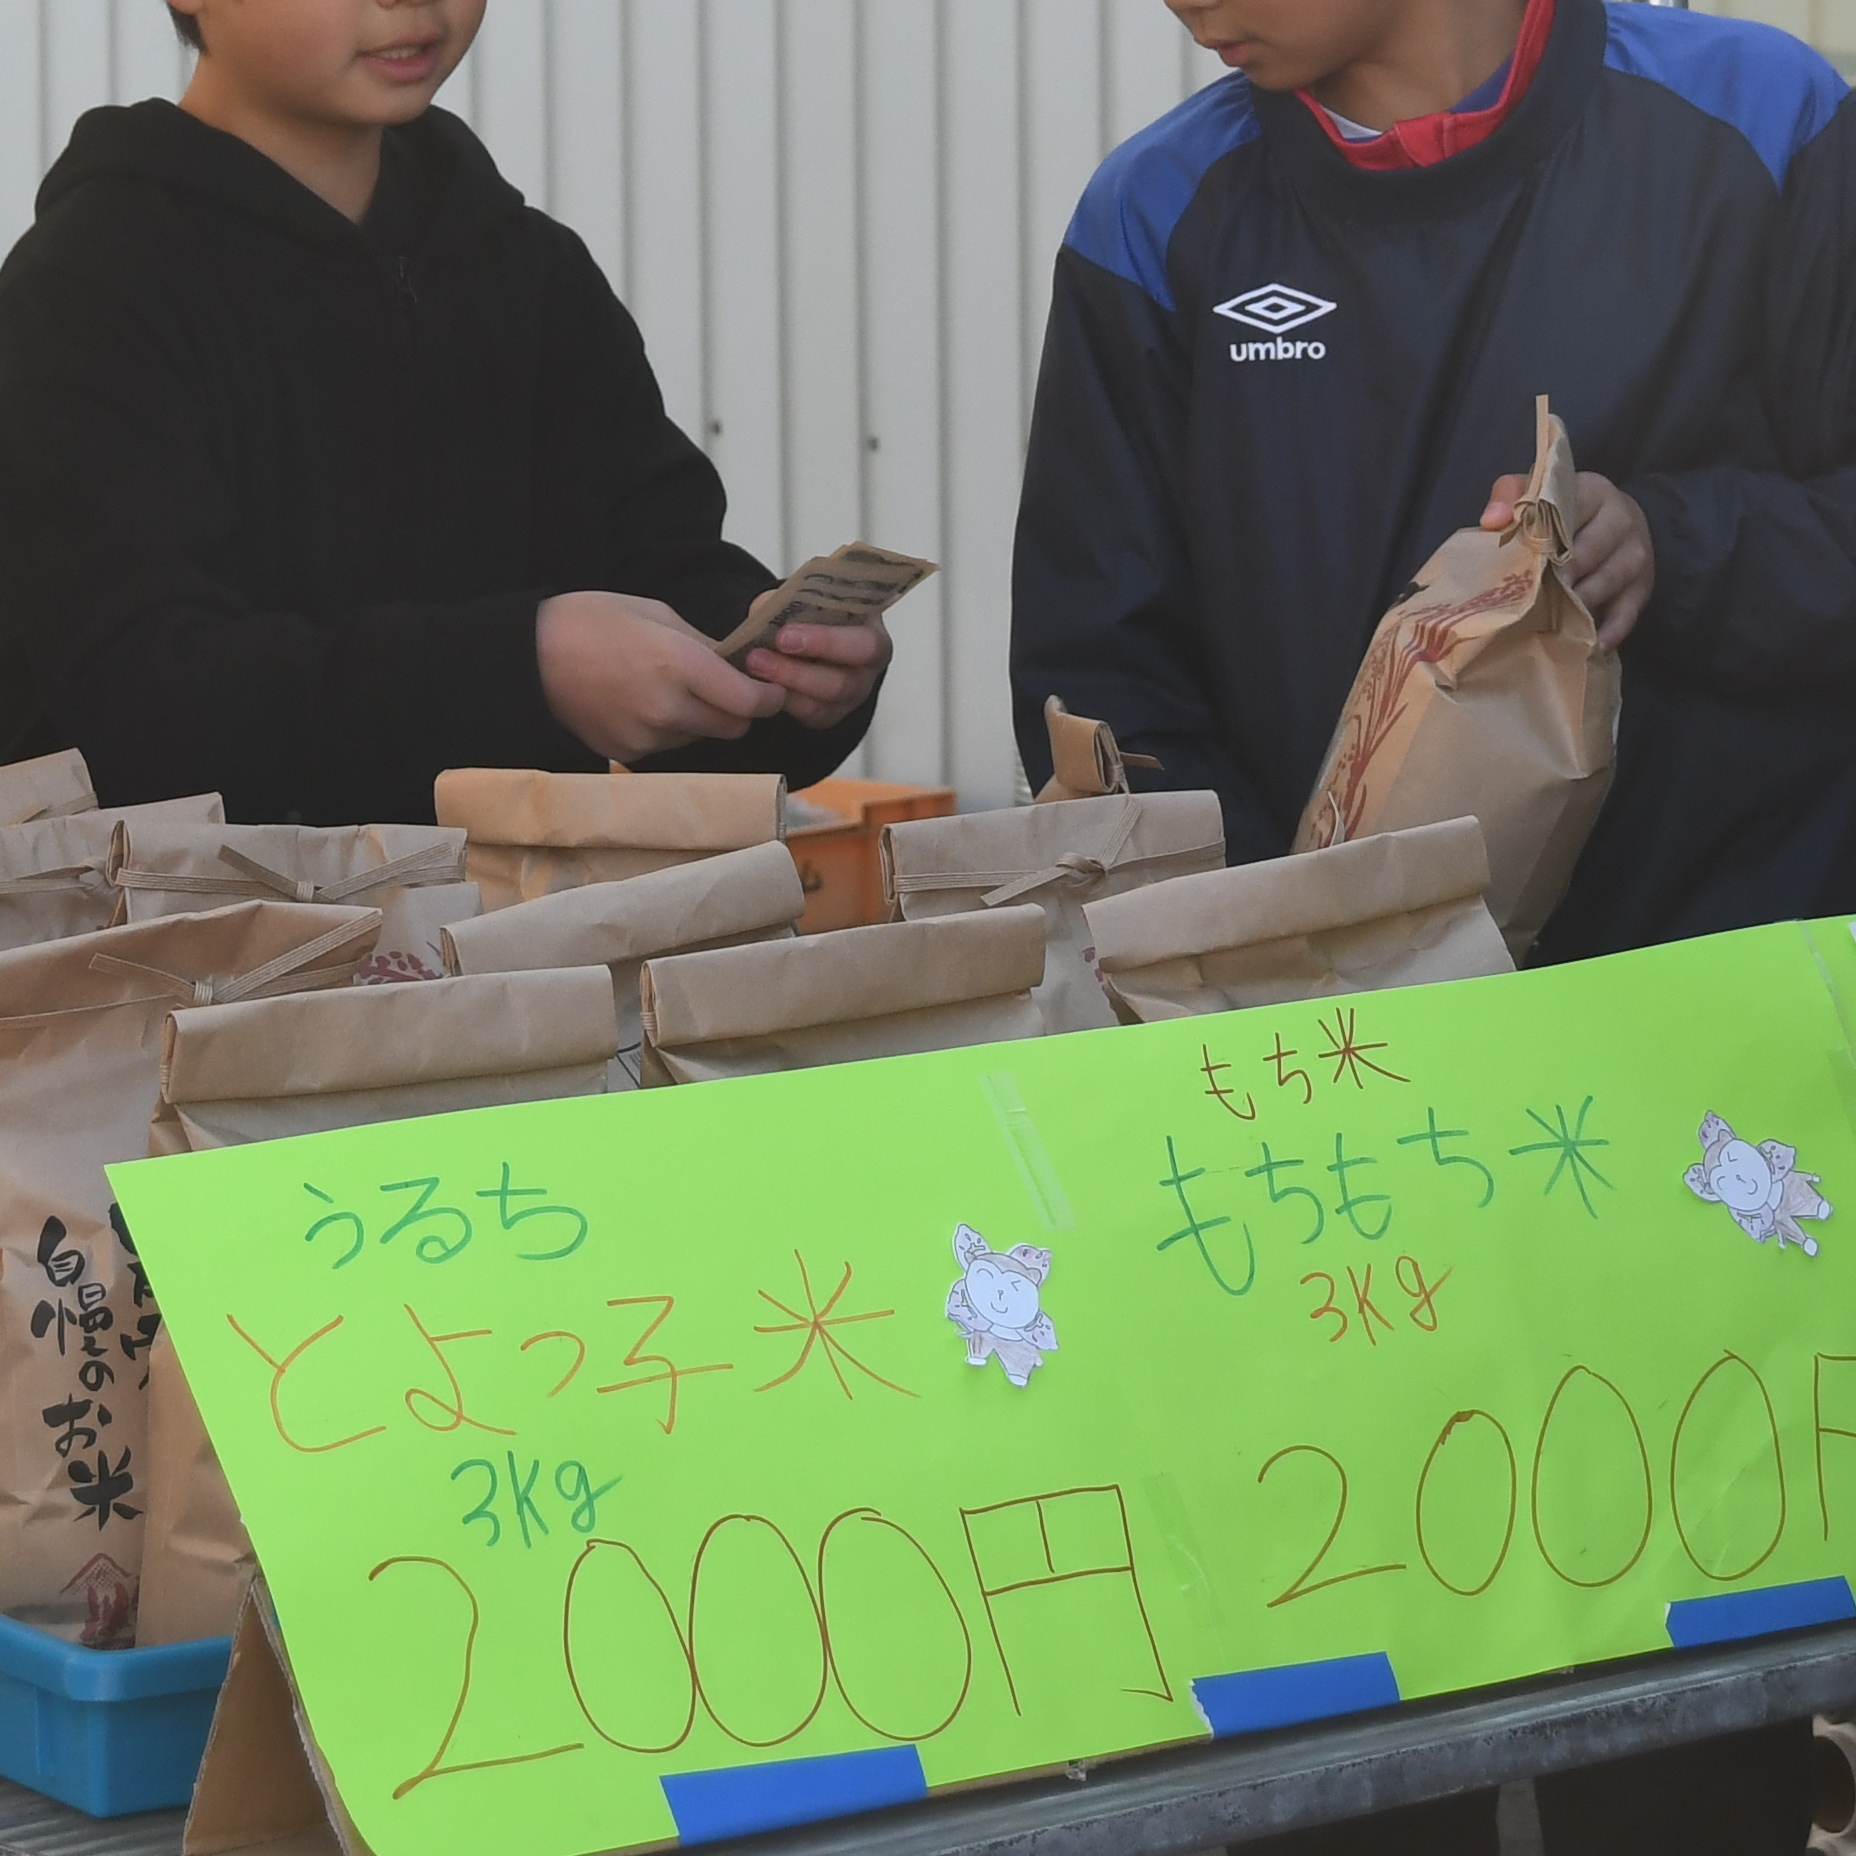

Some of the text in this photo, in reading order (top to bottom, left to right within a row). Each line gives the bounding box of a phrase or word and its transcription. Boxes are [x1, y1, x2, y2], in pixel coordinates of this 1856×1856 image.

[1230, 336, 1326, 362] umbro
[1202, 1007, 1411, 1120] もち米
[303, 1161, 588, 1269] うるち
[1157, 1095, 1616, 1296] もちもち米
[31, 1215, 143, 1531] 自慢のお米
[227, 1248, 922, 1453] とよっ子米
[369, 1485, 1172, 1799] 2000円
